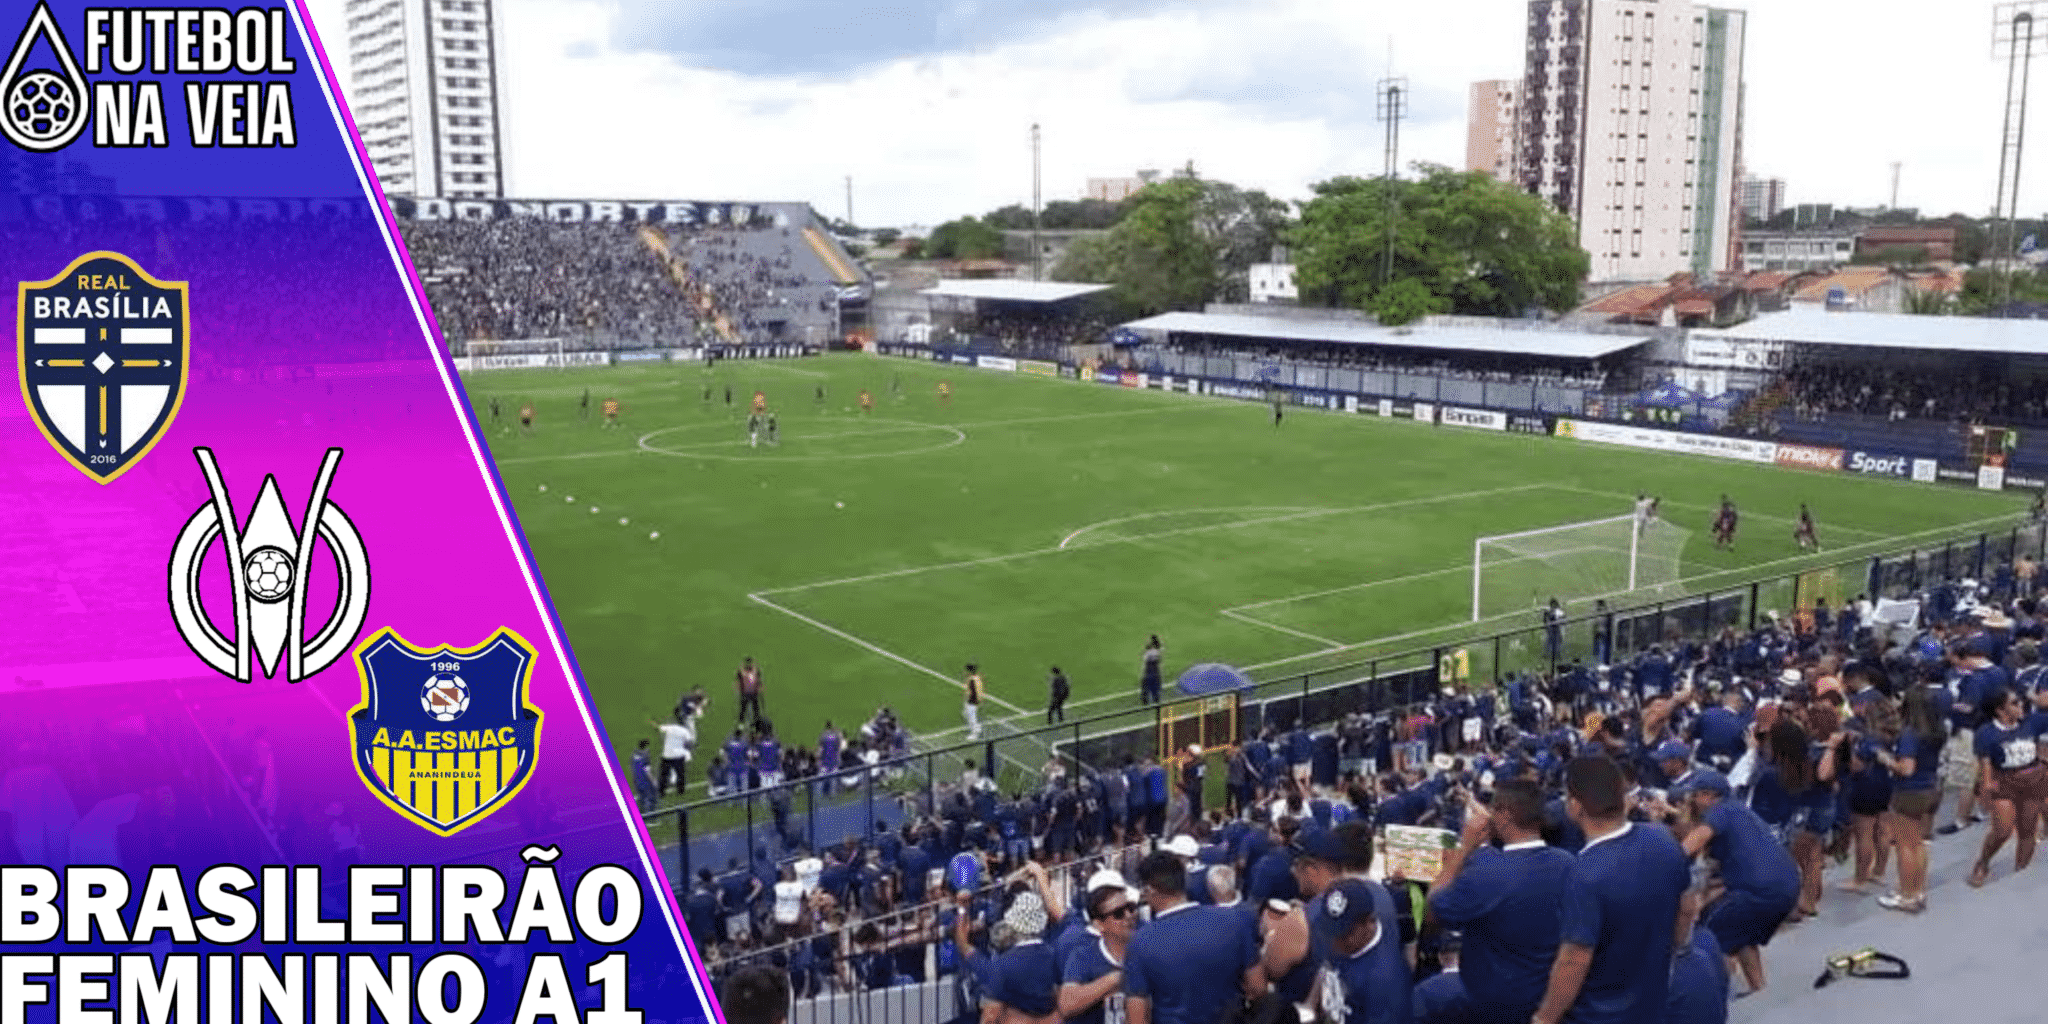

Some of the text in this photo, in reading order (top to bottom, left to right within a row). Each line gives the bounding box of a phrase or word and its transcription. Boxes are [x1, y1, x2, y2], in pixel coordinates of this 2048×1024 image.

[416, 200, 494, 222] DO
[509, 200, 697, 224] NORTE
[1849, 451, 1907, 476] Sport
